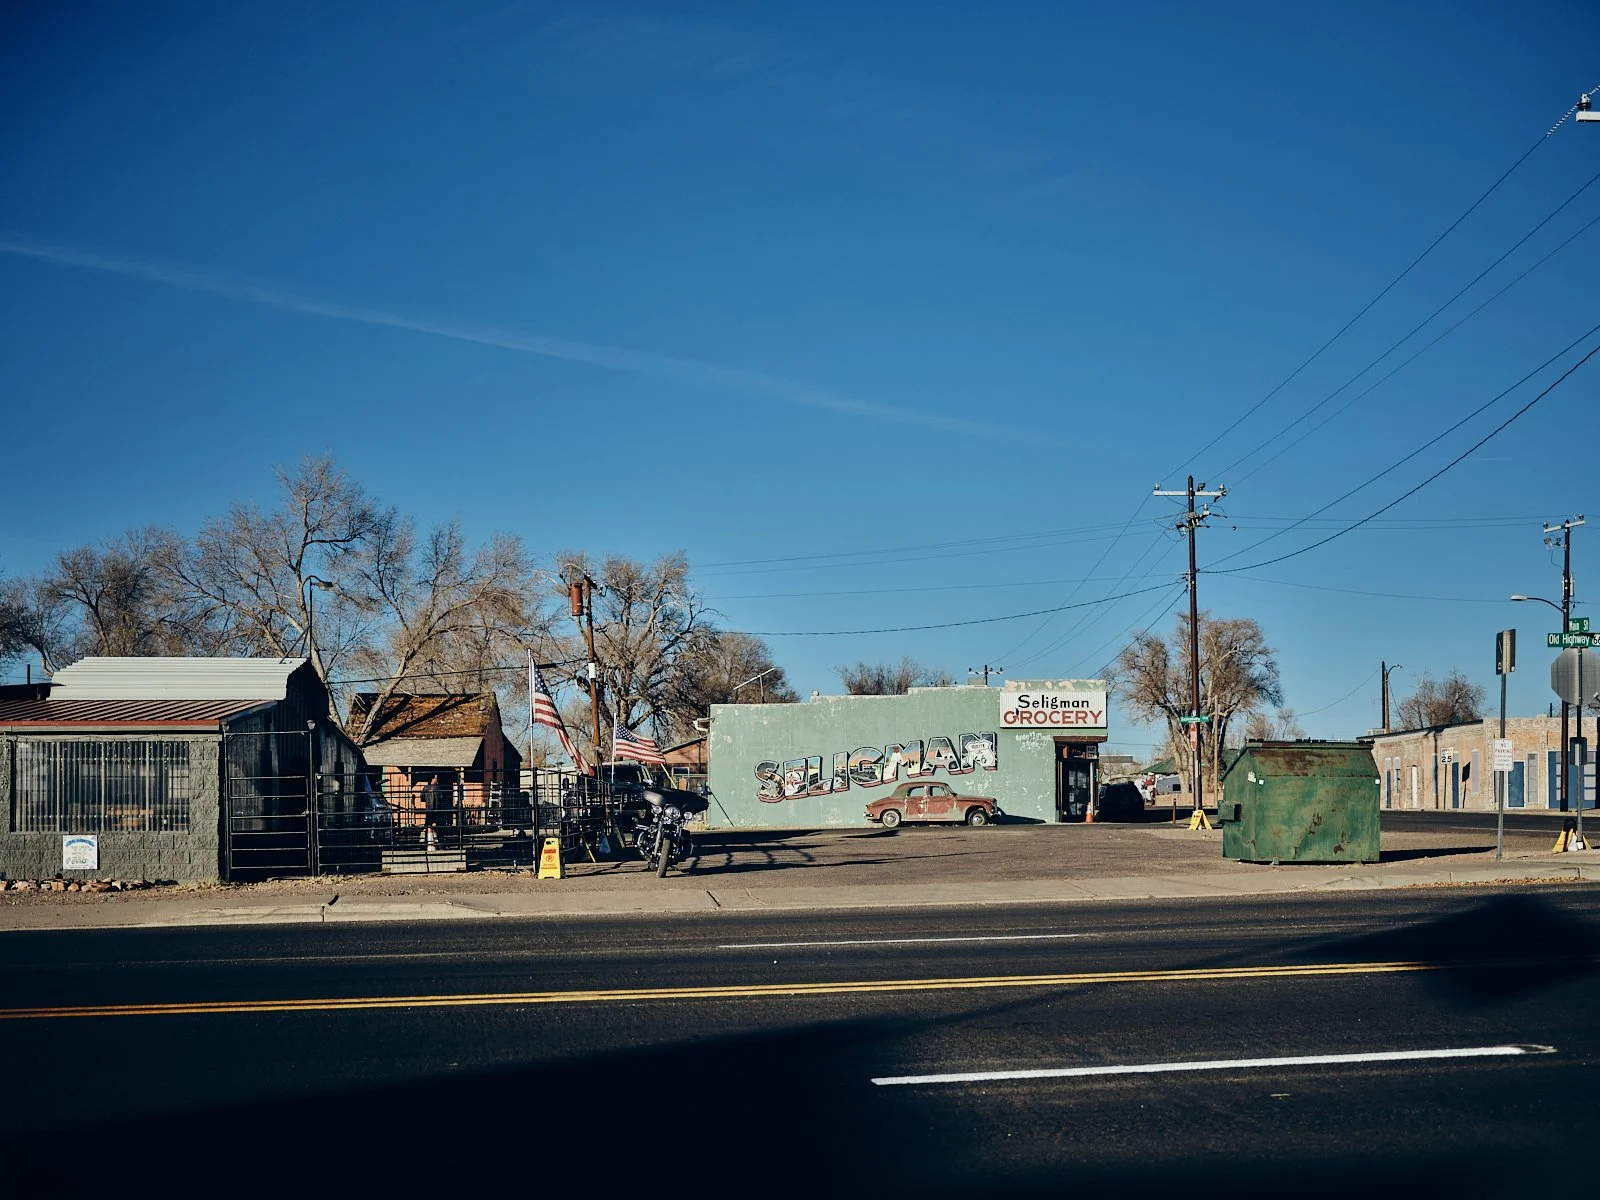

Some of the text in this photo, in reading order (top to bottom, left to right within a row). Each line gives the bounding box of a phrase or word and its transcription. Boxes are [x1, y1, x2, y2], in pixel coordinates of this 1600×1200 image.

[1583, 619, 1589, 631] St
[1548, 633, 1560, 645] Old
[1562, 633, 1590, 647] Highway
[1018, 694, 1090, 710] Seligman
[1003, 710, 1103, 725] GROCERY
[970, 742, 986, 750] ROUTE
[1441, 755, 1453, 763] 25
[754, 731, 998, 804] SELIGMAN
